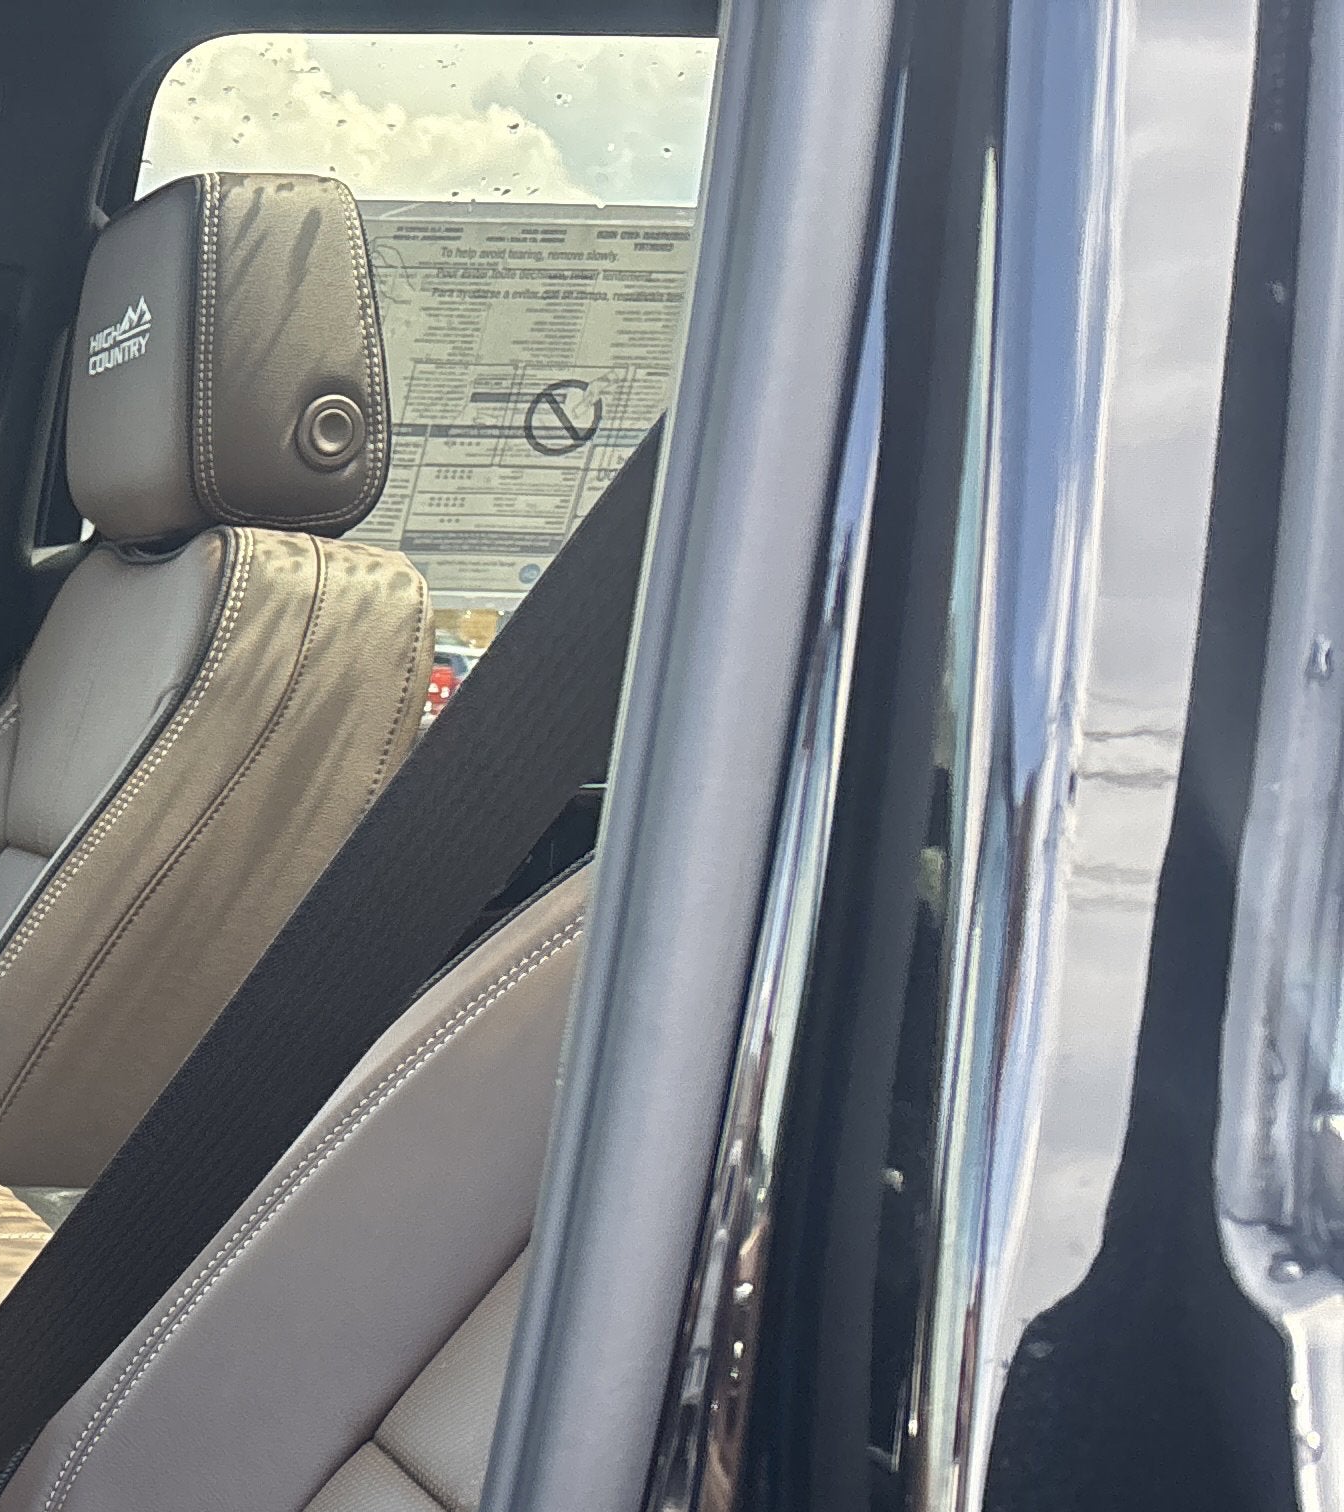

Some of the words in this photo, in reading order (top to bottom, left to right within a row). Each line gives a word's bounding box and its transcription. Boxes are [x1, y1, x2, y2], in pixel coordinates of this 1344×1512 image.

[455, 246, 477, 260] help
[89, 332, 150, 376] COUNTRY
[90, 323, 121, 355] HIGH
